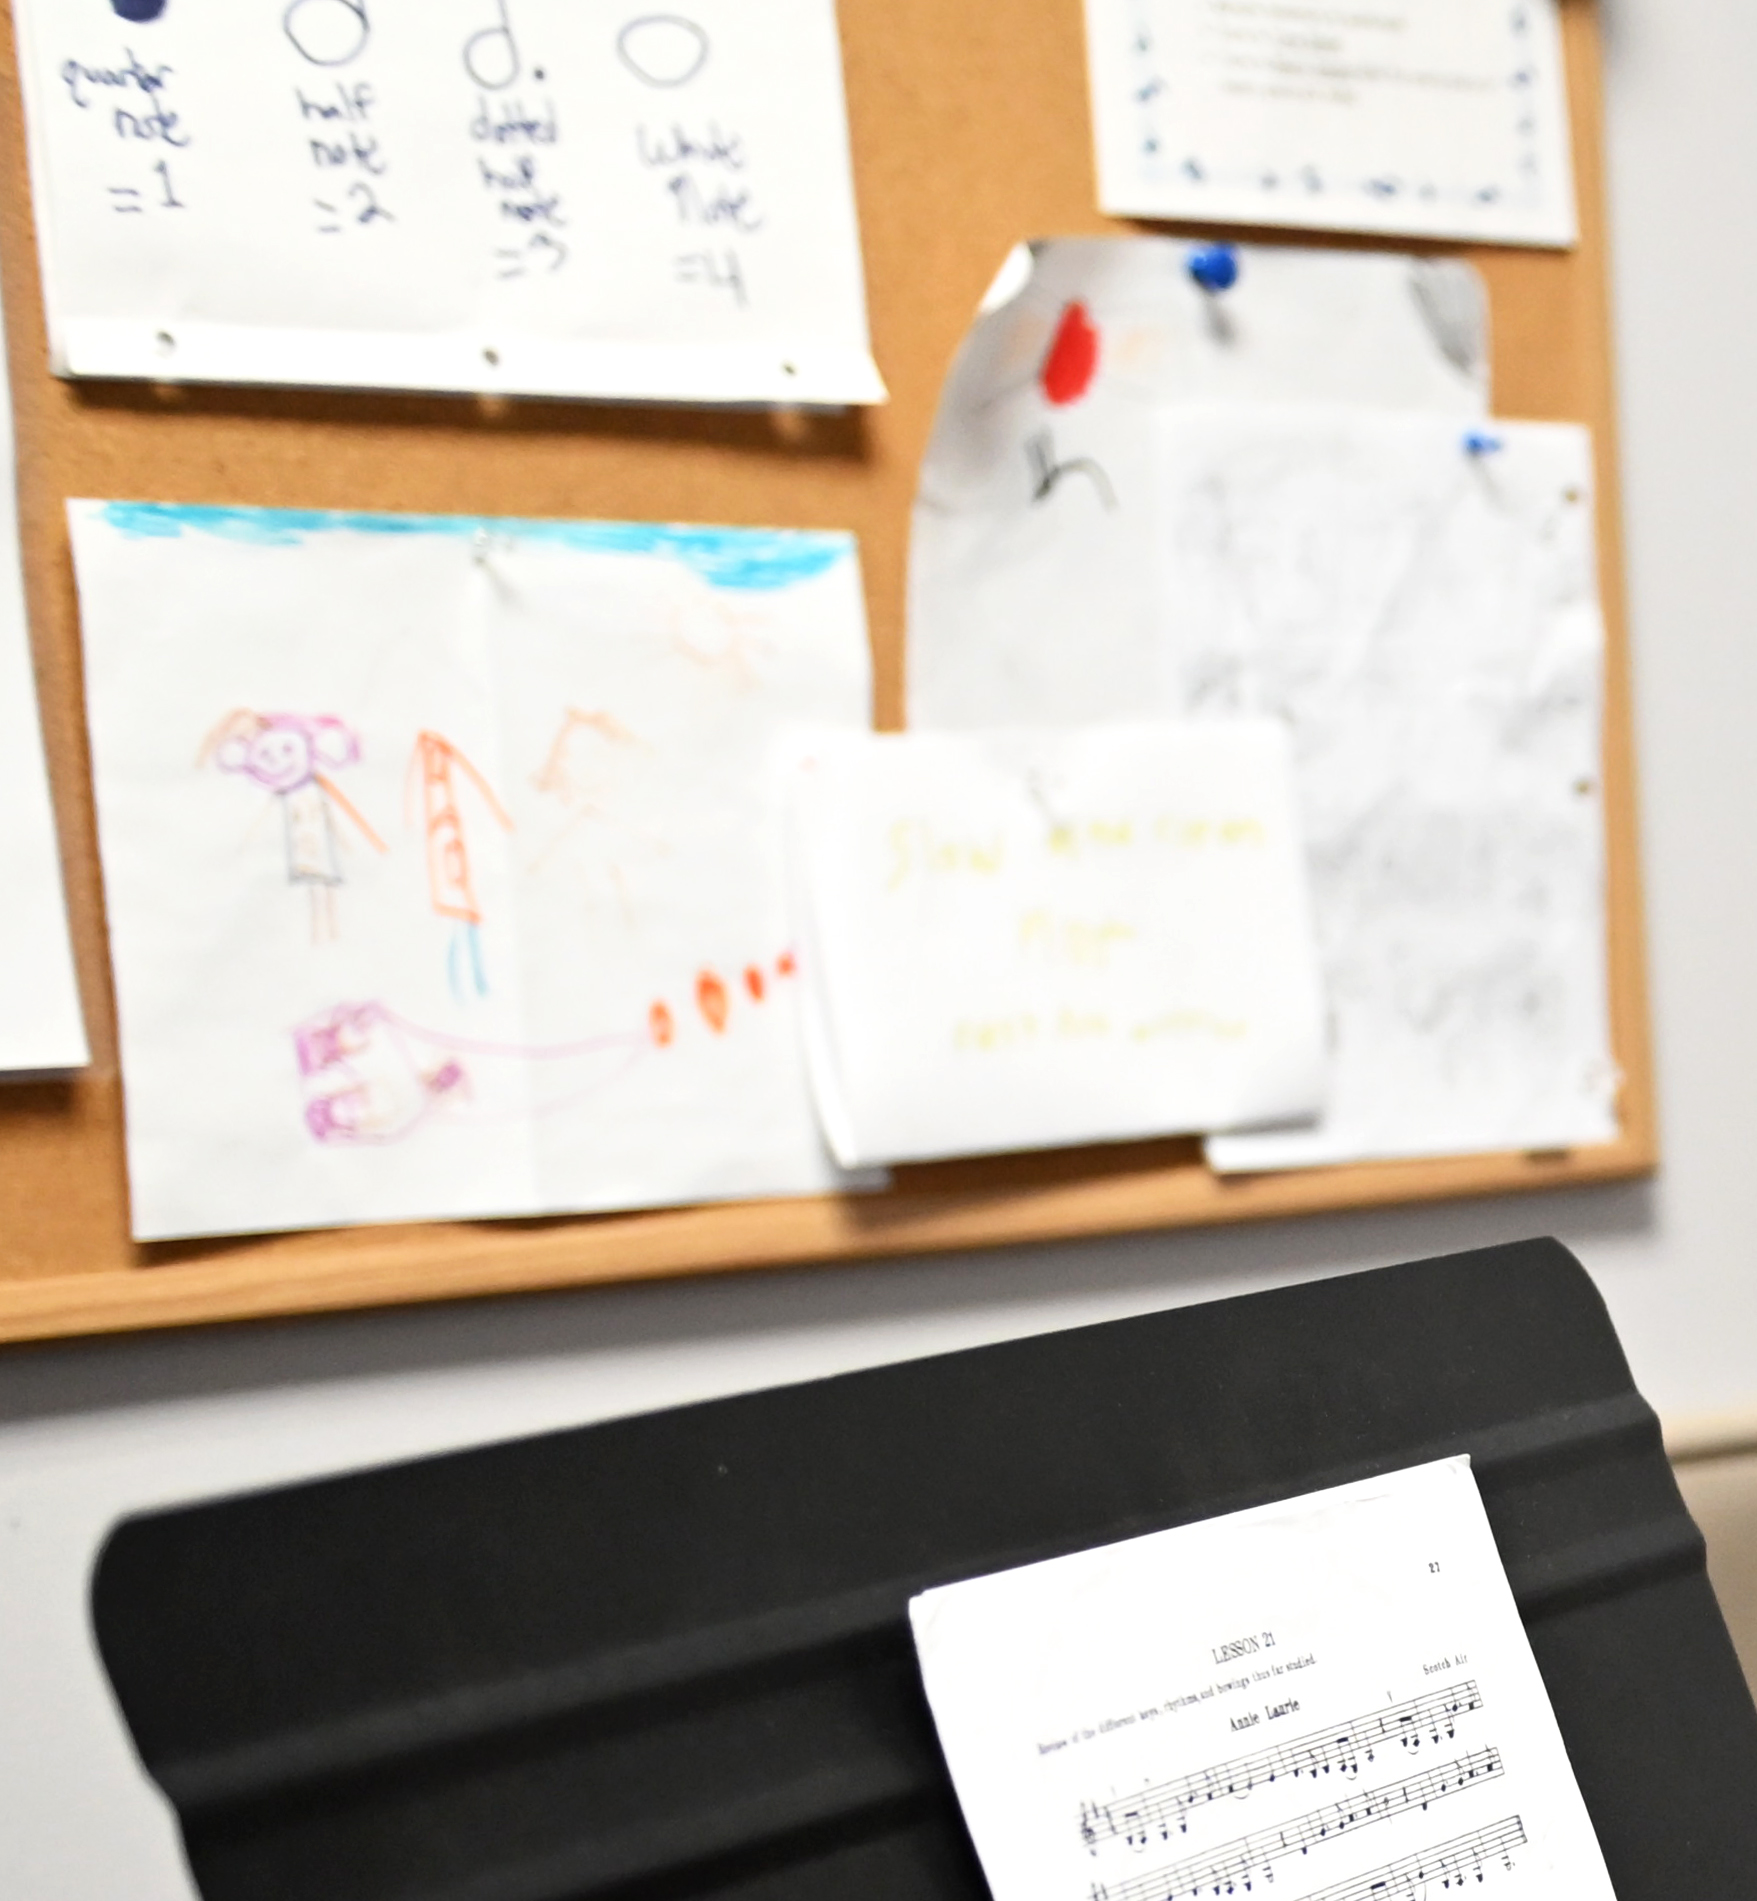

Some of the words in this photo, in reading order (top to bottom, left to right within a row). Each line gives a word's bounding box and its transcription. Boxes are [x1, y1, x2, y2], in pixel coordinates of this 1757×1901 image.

[1212, 1635, 1259, 1664] LESSON
[1262, 1631, 1276, 1647] 21
[1217, 1676, 1250, 1694] bowings
[1252, 1669, 1270, 1682] thus
[1229, 1711, 1260, 1732] Annie
[1265, 1698, 1300, 1721] Laurie
